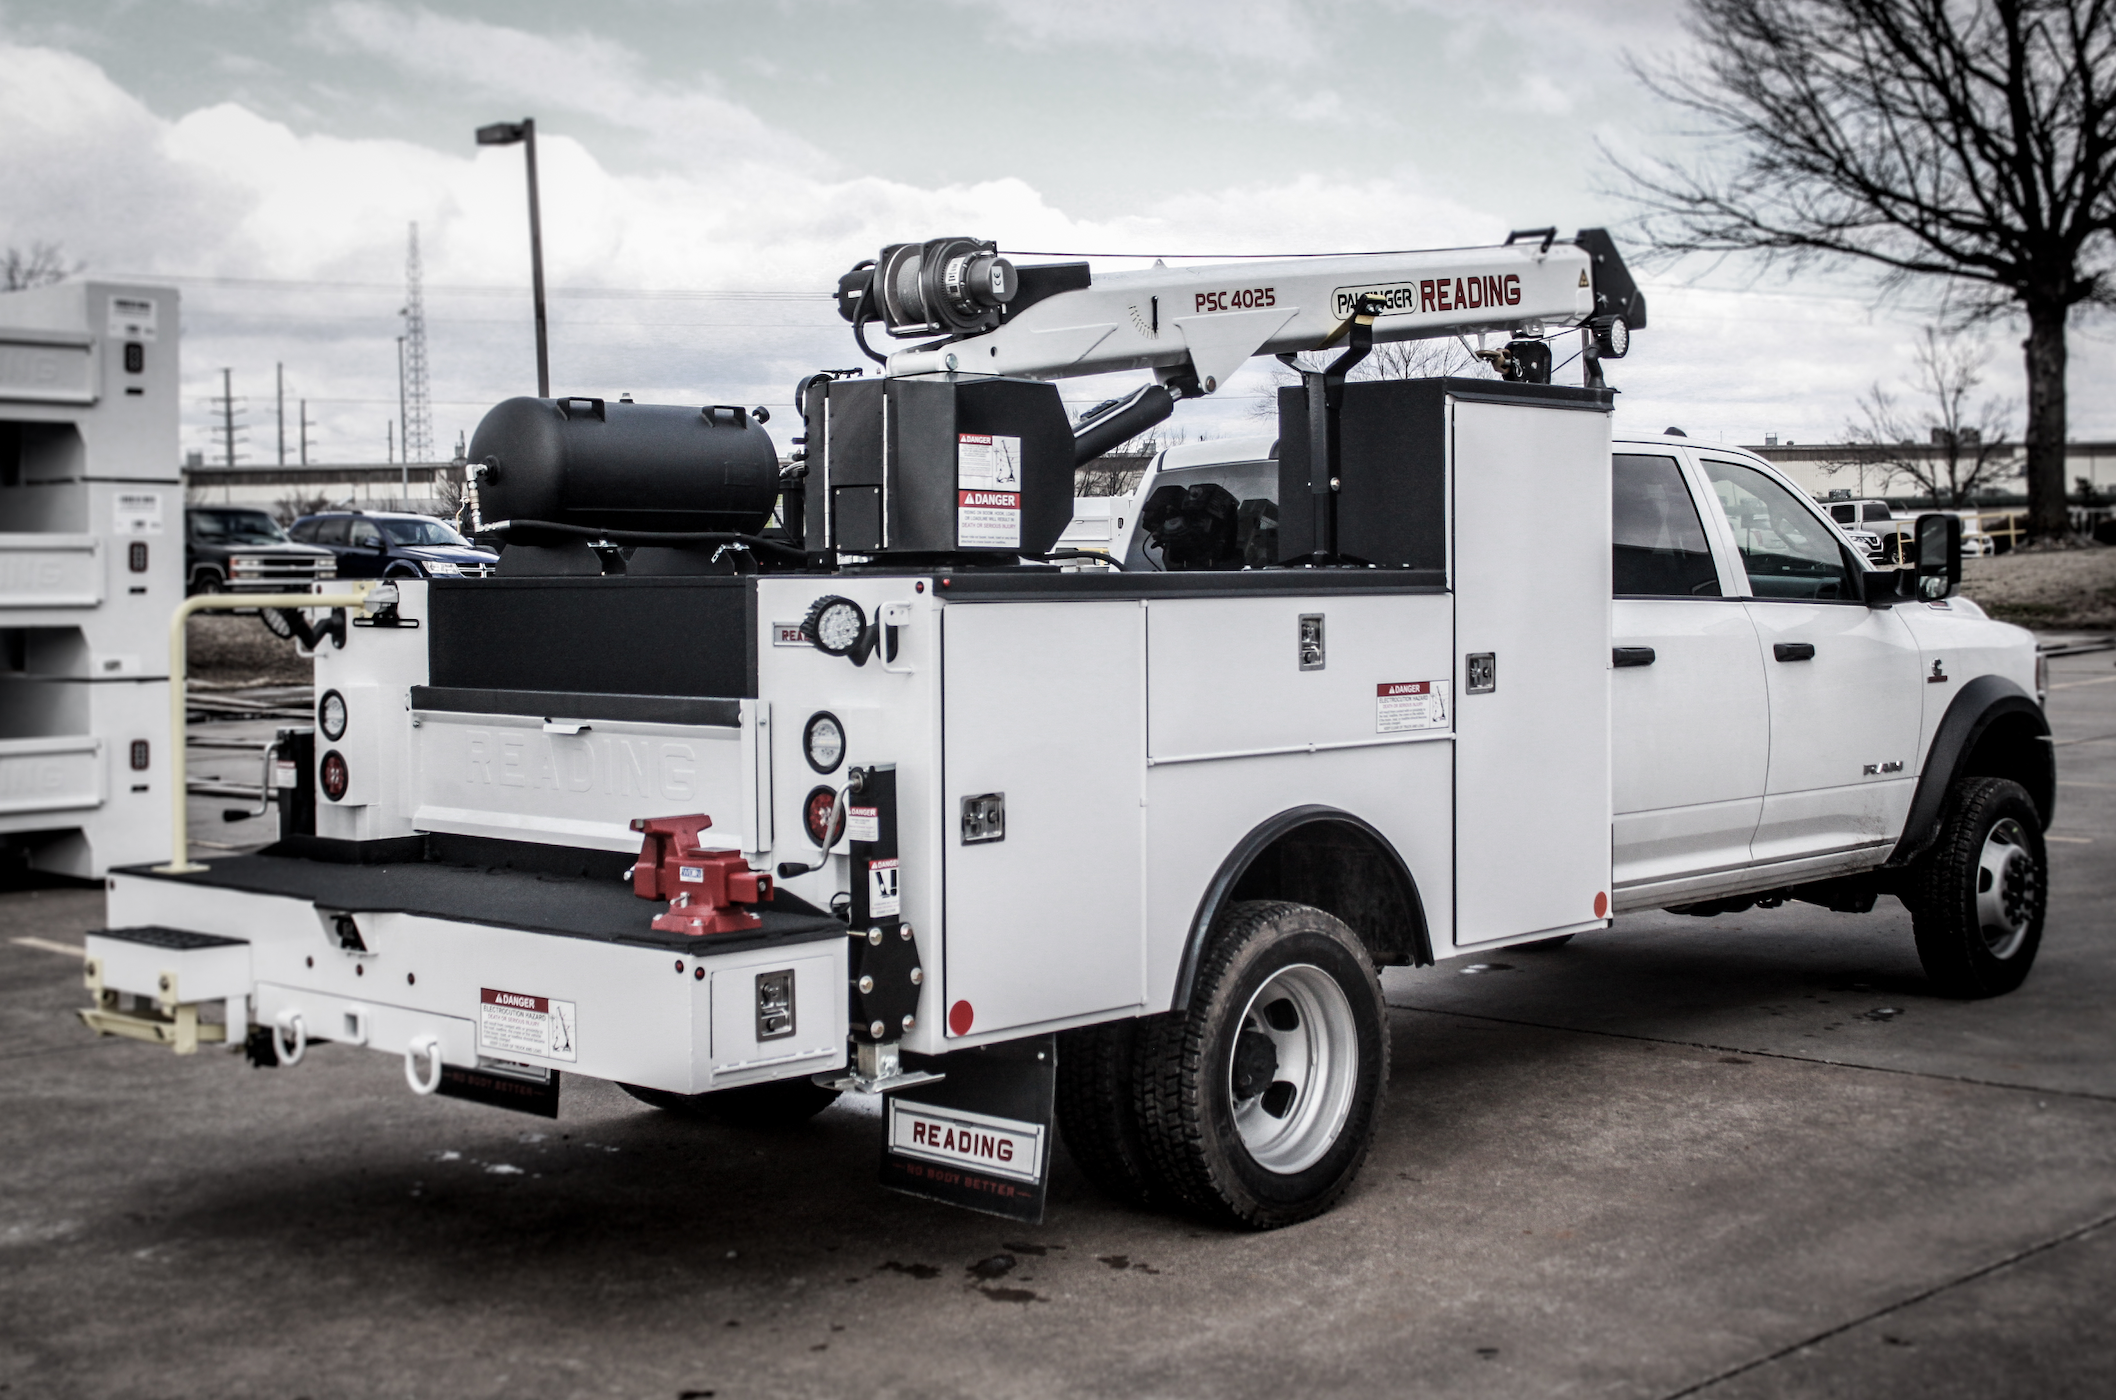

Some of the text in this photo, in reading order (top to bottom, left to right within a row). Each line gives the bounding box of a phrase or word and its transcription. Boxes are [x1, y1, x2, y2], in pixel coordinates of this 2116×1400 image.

[1195, 287, 1276, 313] PSC 4025
[1337, 274, 1521, 314] PAGER READING
[966, 435, 991, 444] DANGER
[975, 494, 1015, 506] DANGER
[1395, 685, 1420, 693] DANGER
[466, 730, 696, 801] READING
[851, 808, 877, 817] DANGER
[503, 994, 535, 1009] DANGER
[913, 1121, 1014, 1162] READING
[907, 1163, 1015, 1198] NO BODY BETTER
